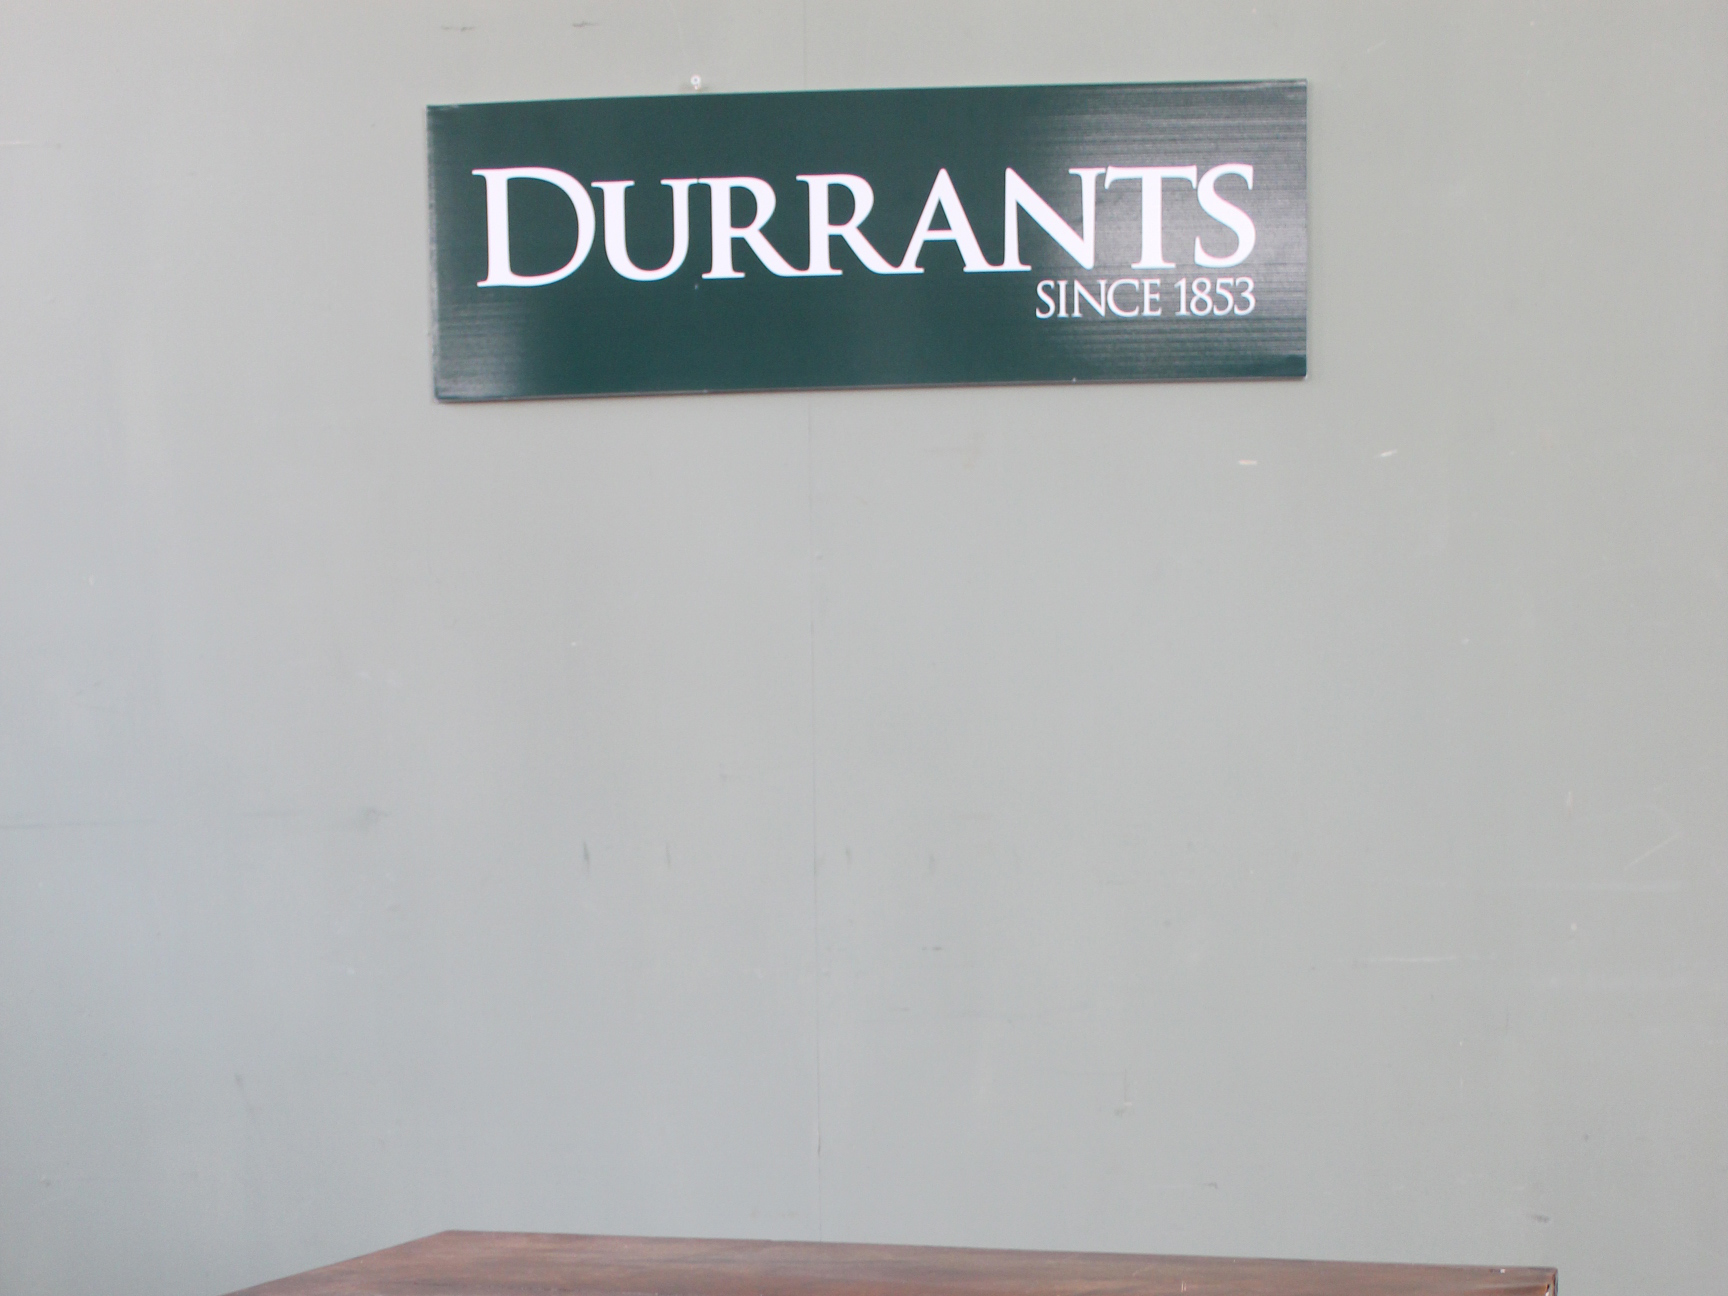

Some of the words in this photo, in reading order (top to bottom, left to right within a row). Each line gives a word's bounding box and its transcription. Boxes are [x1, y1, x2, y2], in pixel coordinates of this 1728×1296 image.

[471, 162, 1257, 288] DURRANTS
[1034, 278, 1162, 319] SINCE
[1174, 276, 1257, 318] 1853
